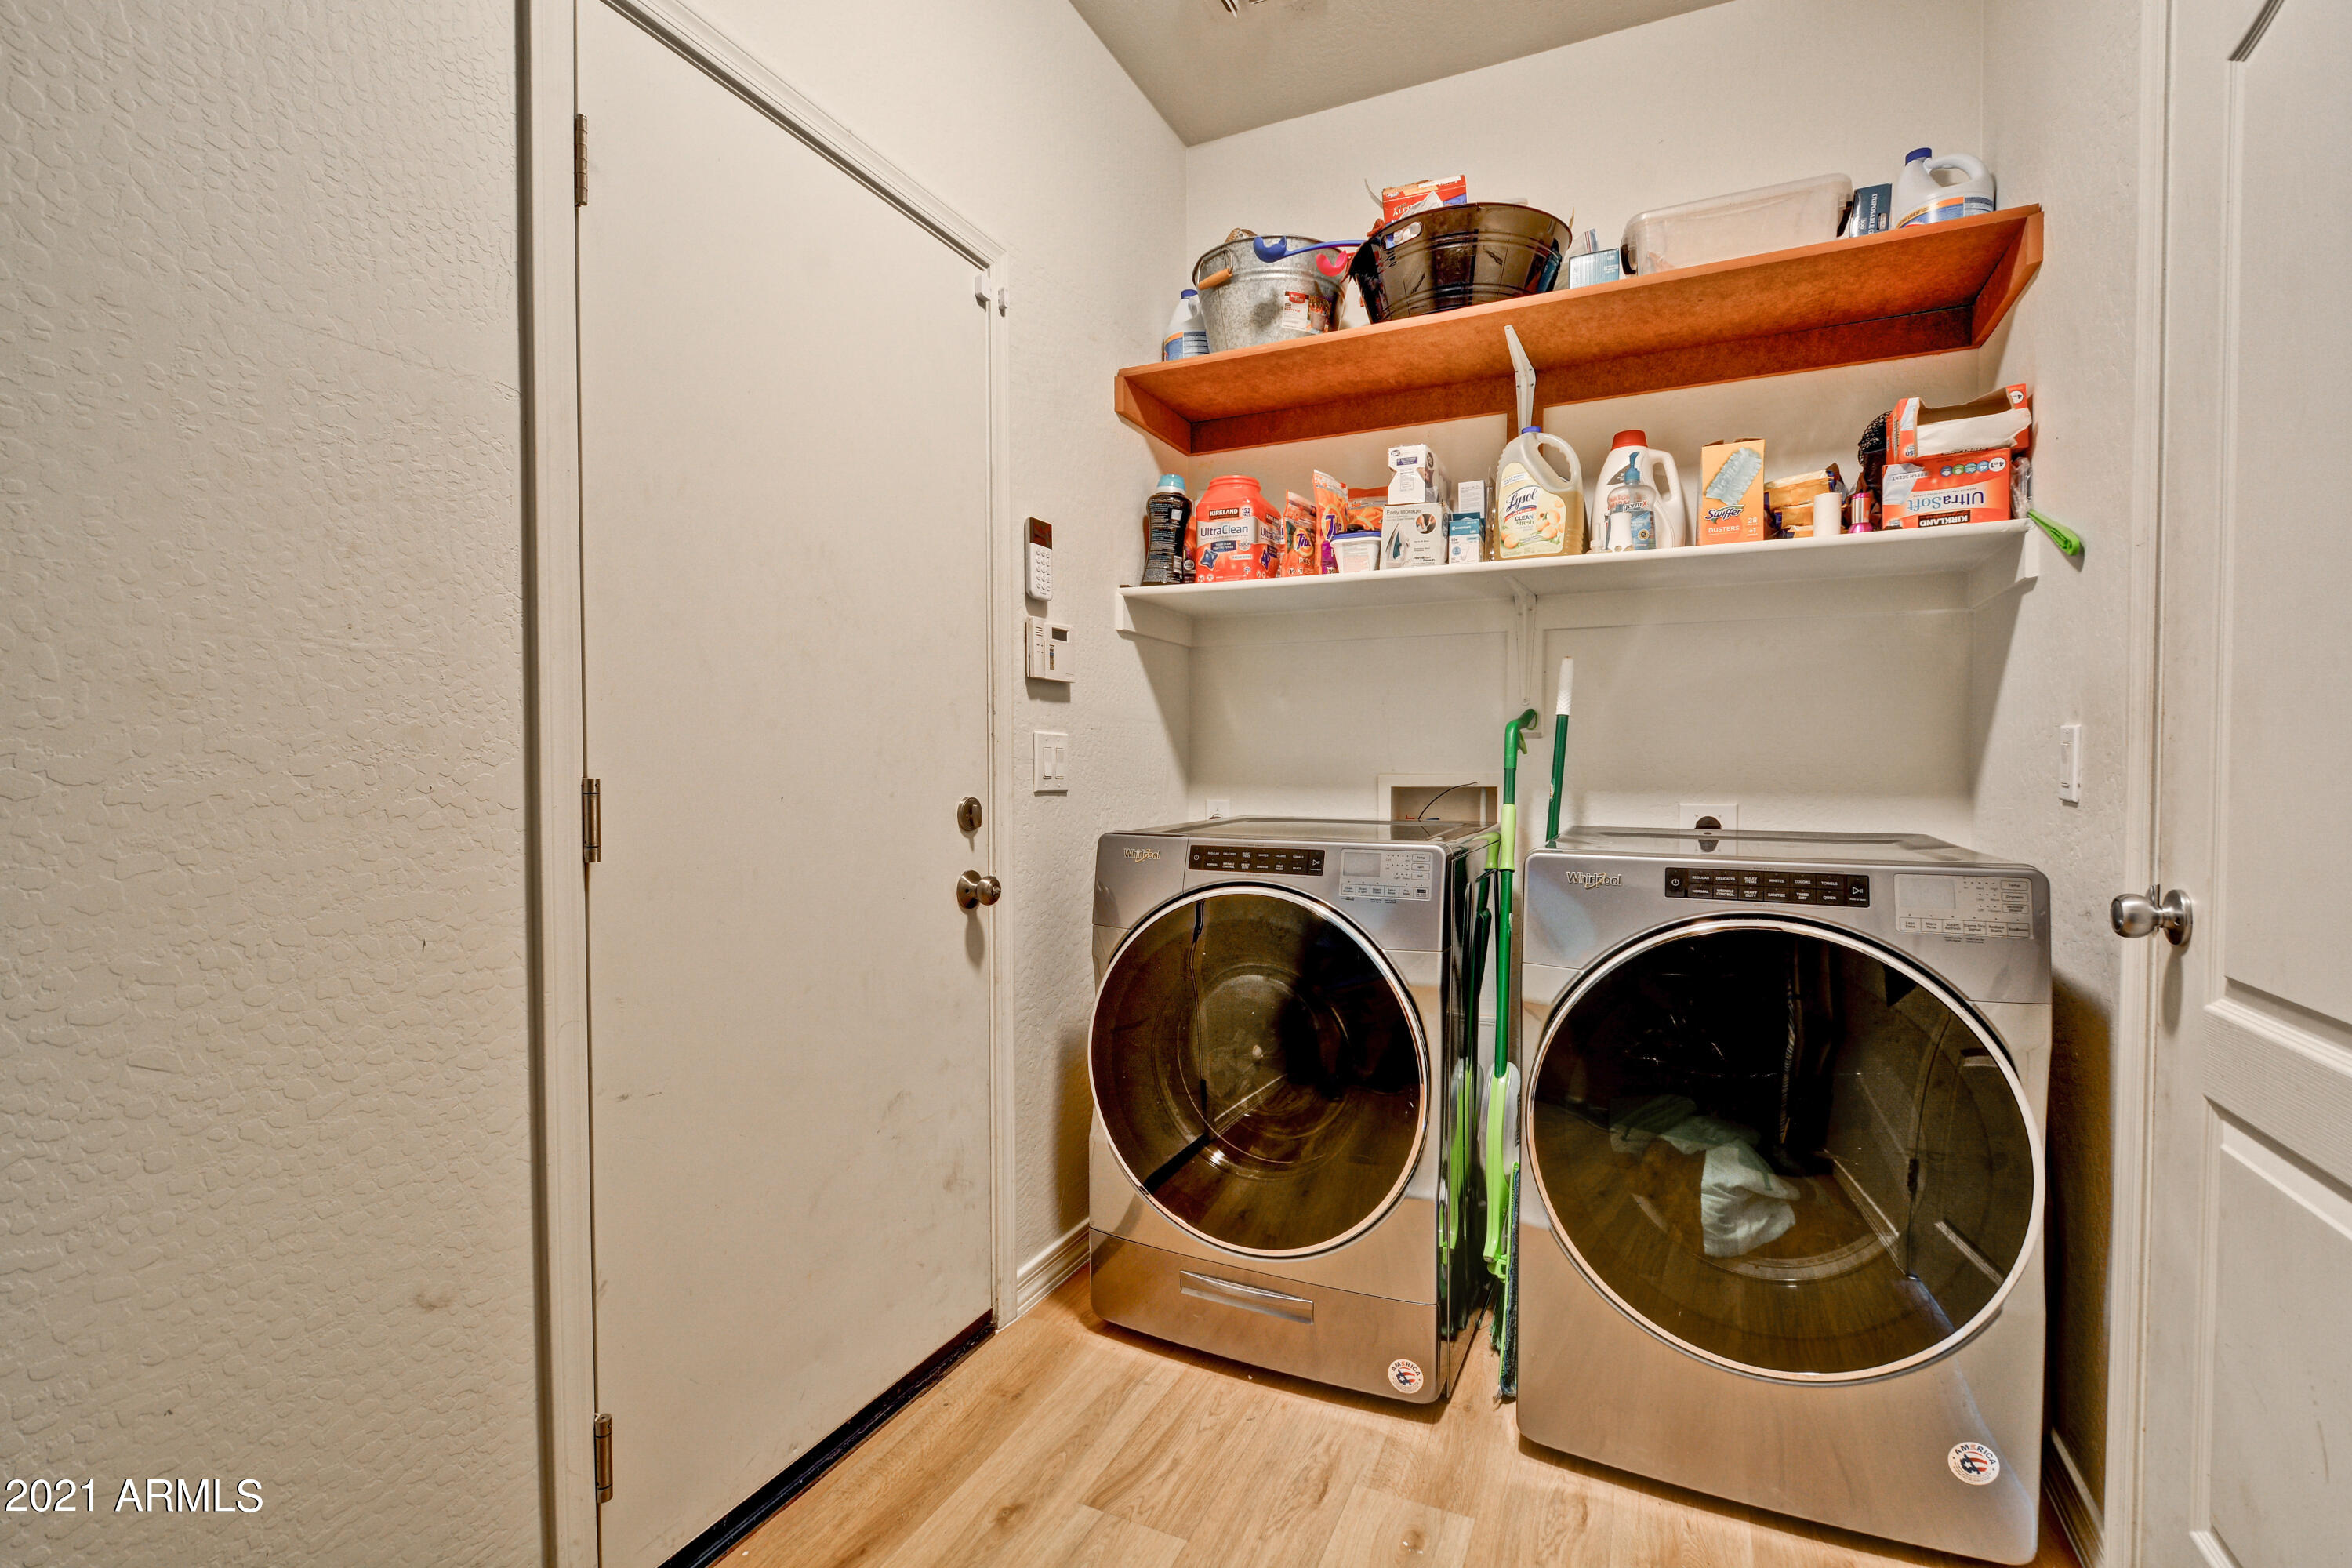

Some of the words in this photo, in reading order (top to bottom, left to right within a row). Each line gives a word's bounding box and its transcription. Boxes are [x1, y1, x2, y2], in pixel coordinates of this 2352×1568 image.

[1869, 194, 1878, 227] DISPOSABLE
[1506, 488, 1537, 512] Lysol
[1907, 491, 1984, 512] UltraSoft
[1210, 508, 1238, 517] KIRKLAND
[1704, 507, 1742, 521] Swiffer
[1919, 514, 1969, 527] KIRKLAND
[1200, 524, 1249, 537] UltraClean
[1123, 848, 1160, 862] Whirlpool
[1566, 872, 1622, 888] Whirlpool
[1392, 1361, 1421, 1376] AMERICA
[1955, 1444, 1996, 1465] AMERICA
